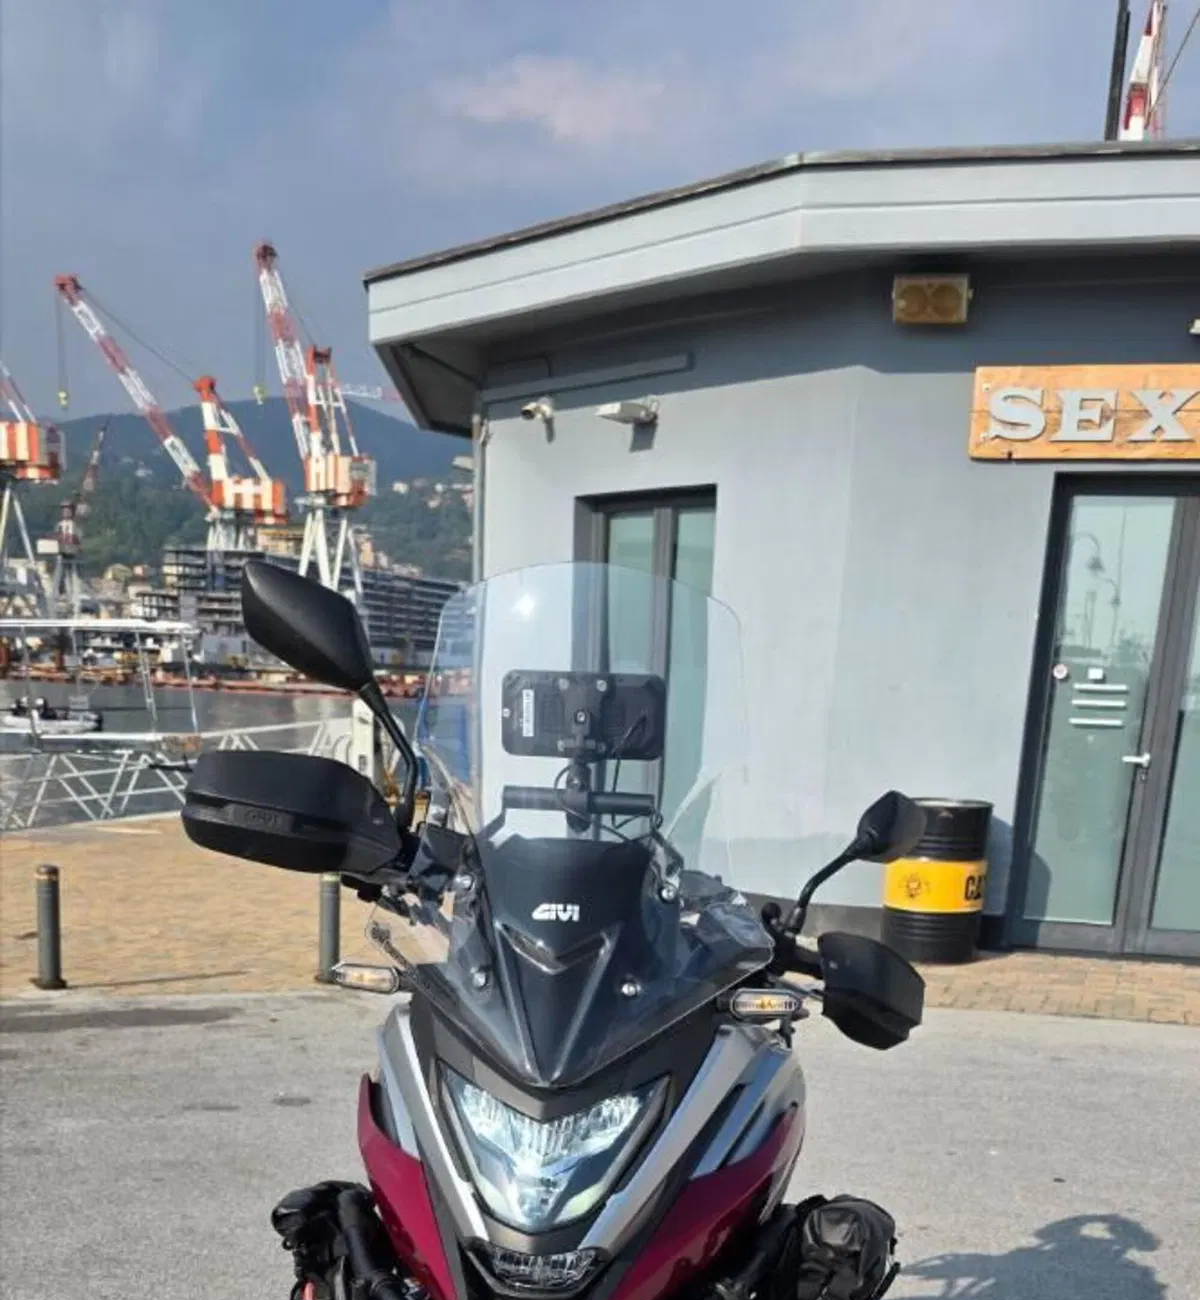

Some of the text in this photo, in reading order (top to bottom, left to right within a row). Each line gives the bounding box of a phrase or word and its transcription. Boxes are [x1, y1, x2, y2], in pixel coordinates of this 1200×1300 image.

[989, 387, 1200, 441] SEX
[965, 875, 985, 901] CA
[531, 903, 580, 921] GIVI
